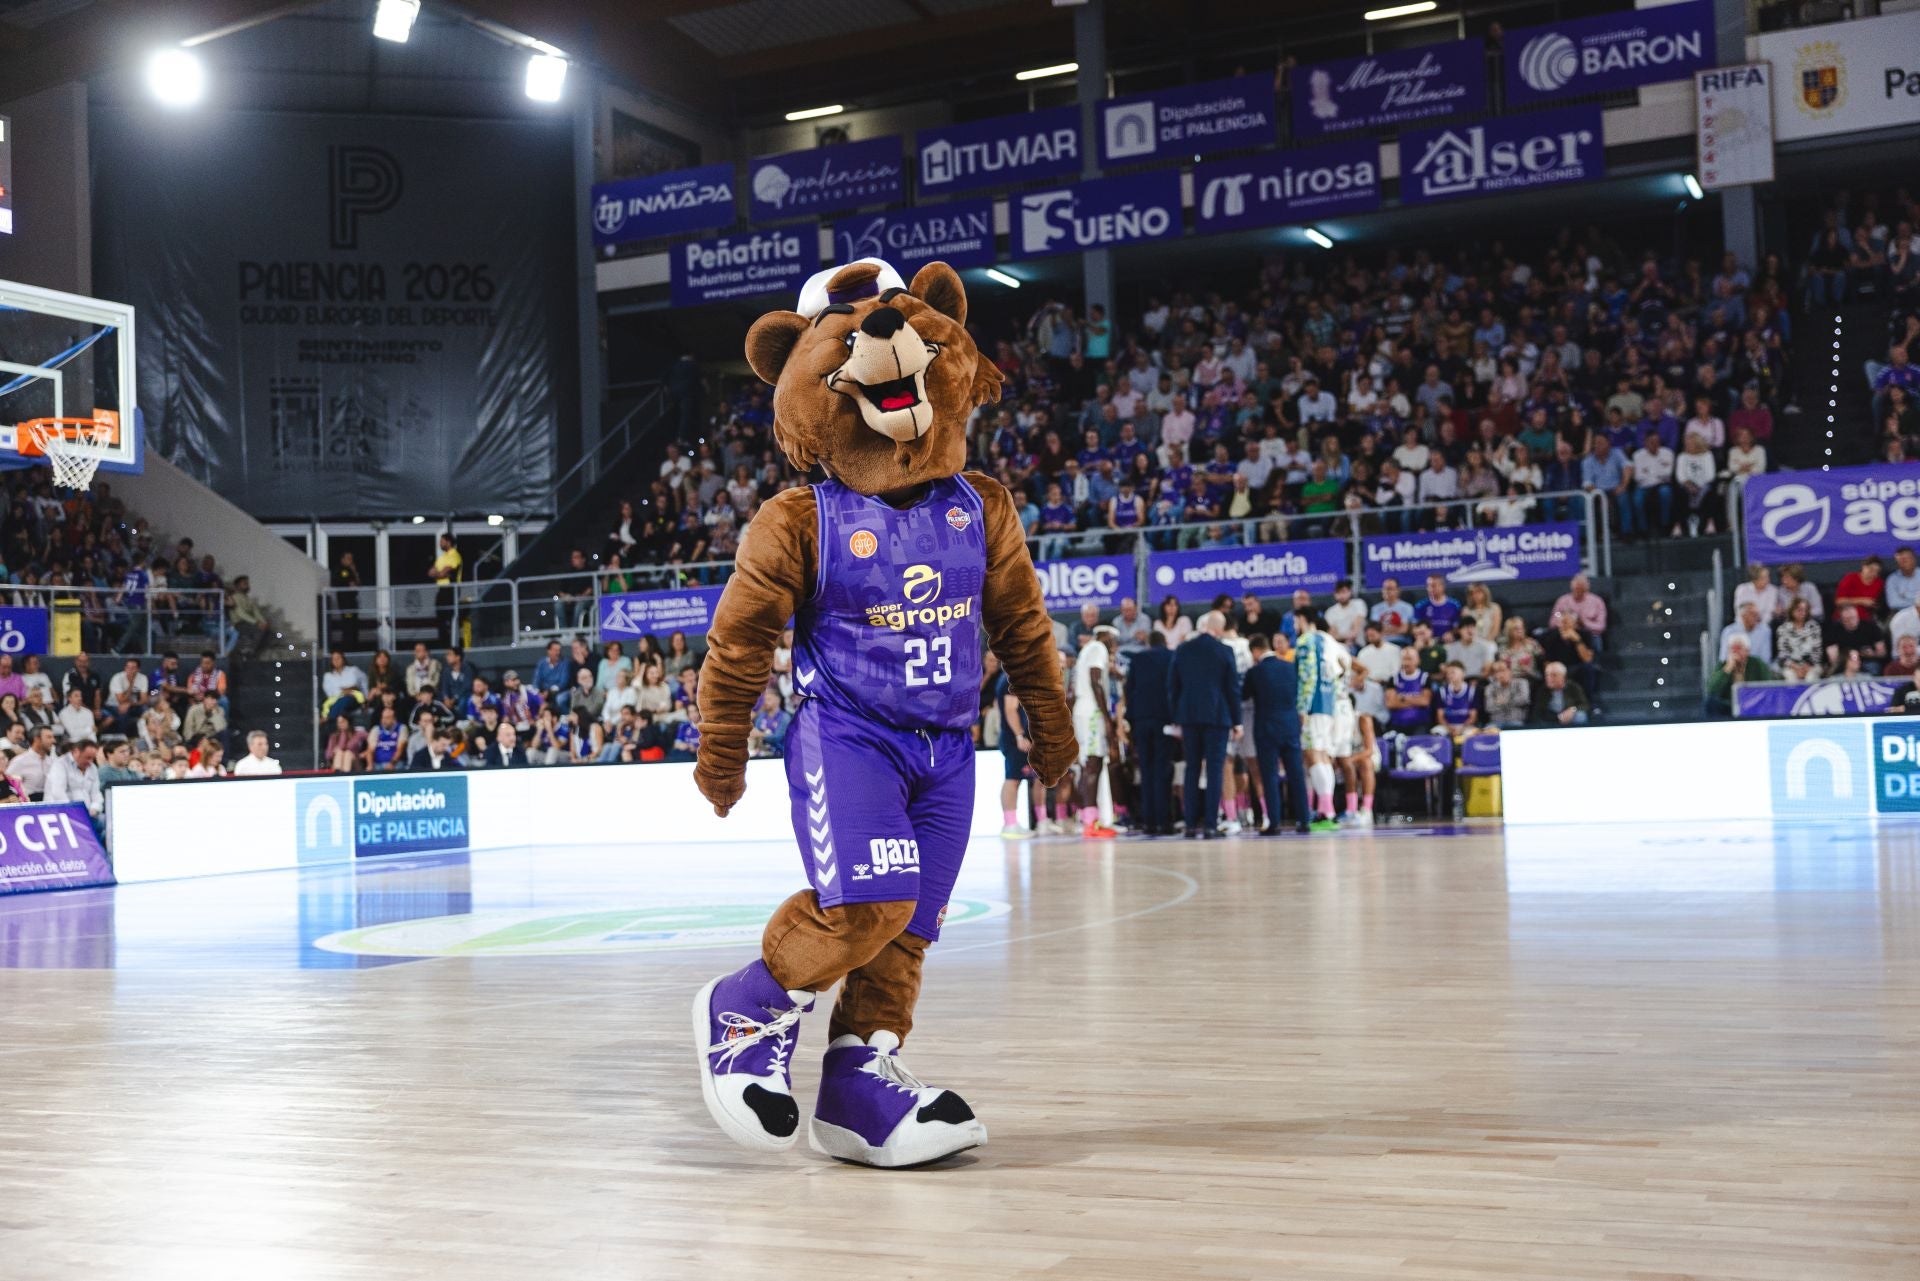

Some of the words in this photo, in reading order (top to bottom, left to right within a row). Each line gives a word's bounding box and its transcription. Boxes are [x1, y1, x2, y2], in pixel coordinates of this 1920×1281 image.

[1583, 30, 1701, 75] BARON
[1701, 68, 1764, 93] RIFA
[1885, 68, 1920, 99] Pa
[1160, 97, 1246, 122] Diputación
[1704, 116, 1714, 128] 2
[1161, 126, 1183, 142] DE
[1186, 112, 1267, 137] PALENCIA
[922, 127, 1077, 185] HITUMAR
[1432, 126, 1593, 185] alser
[1704, 152, 1714, 164] 4
[1259, 161, 1375, 201] nirosa
[1483, 167, 1584, 190] INSTALACIONES
[628, 183, 733, 216] INMAPA
[886, 211, 988, 248] GABAN
[686, 231, 800, 271] Peñafría
[902, 247, 934, 260] MODA
[936, 240, 982, 255] HOMBRE
[239, 261, 386, 302] PALENCIA
[404, 263, 495, 303] 2026
[688, 271, 744, 288] Industrias
[746, 263, 801, 280] Cárnicas
[240, 306, 299, 325] CIUDAD
[305, 306, 382, 325] EUROPEA
[387, 306, 417, 325] DEL
[422, 306, 497, 327] DEPORTE
[299, 339, 443, 352] SENTIMIENTO
[1368, 543, 1392, 562] La
[1395, 538, 1476, 559] Montaña
[1486, 533, 1516, 553] del
[1518, 531, 1573, 551] Cristo
[1183, 552, 1307, 583] redmediaria
[865, 603, 902, 615] súper
[868, 596, 972, 631] agropal
[904, 636, 951, 687] 23
[1882, 735, 1920, 768] Di
[357, 787, 446, 818] Diputación
[15, 812, 79, 852] CFI
[359, 822, 383, 845] DE
[387, 817, 466, 842] PALENCIA
[45, 860, 59, 873] de
[59, 859, 87, 873] datos
